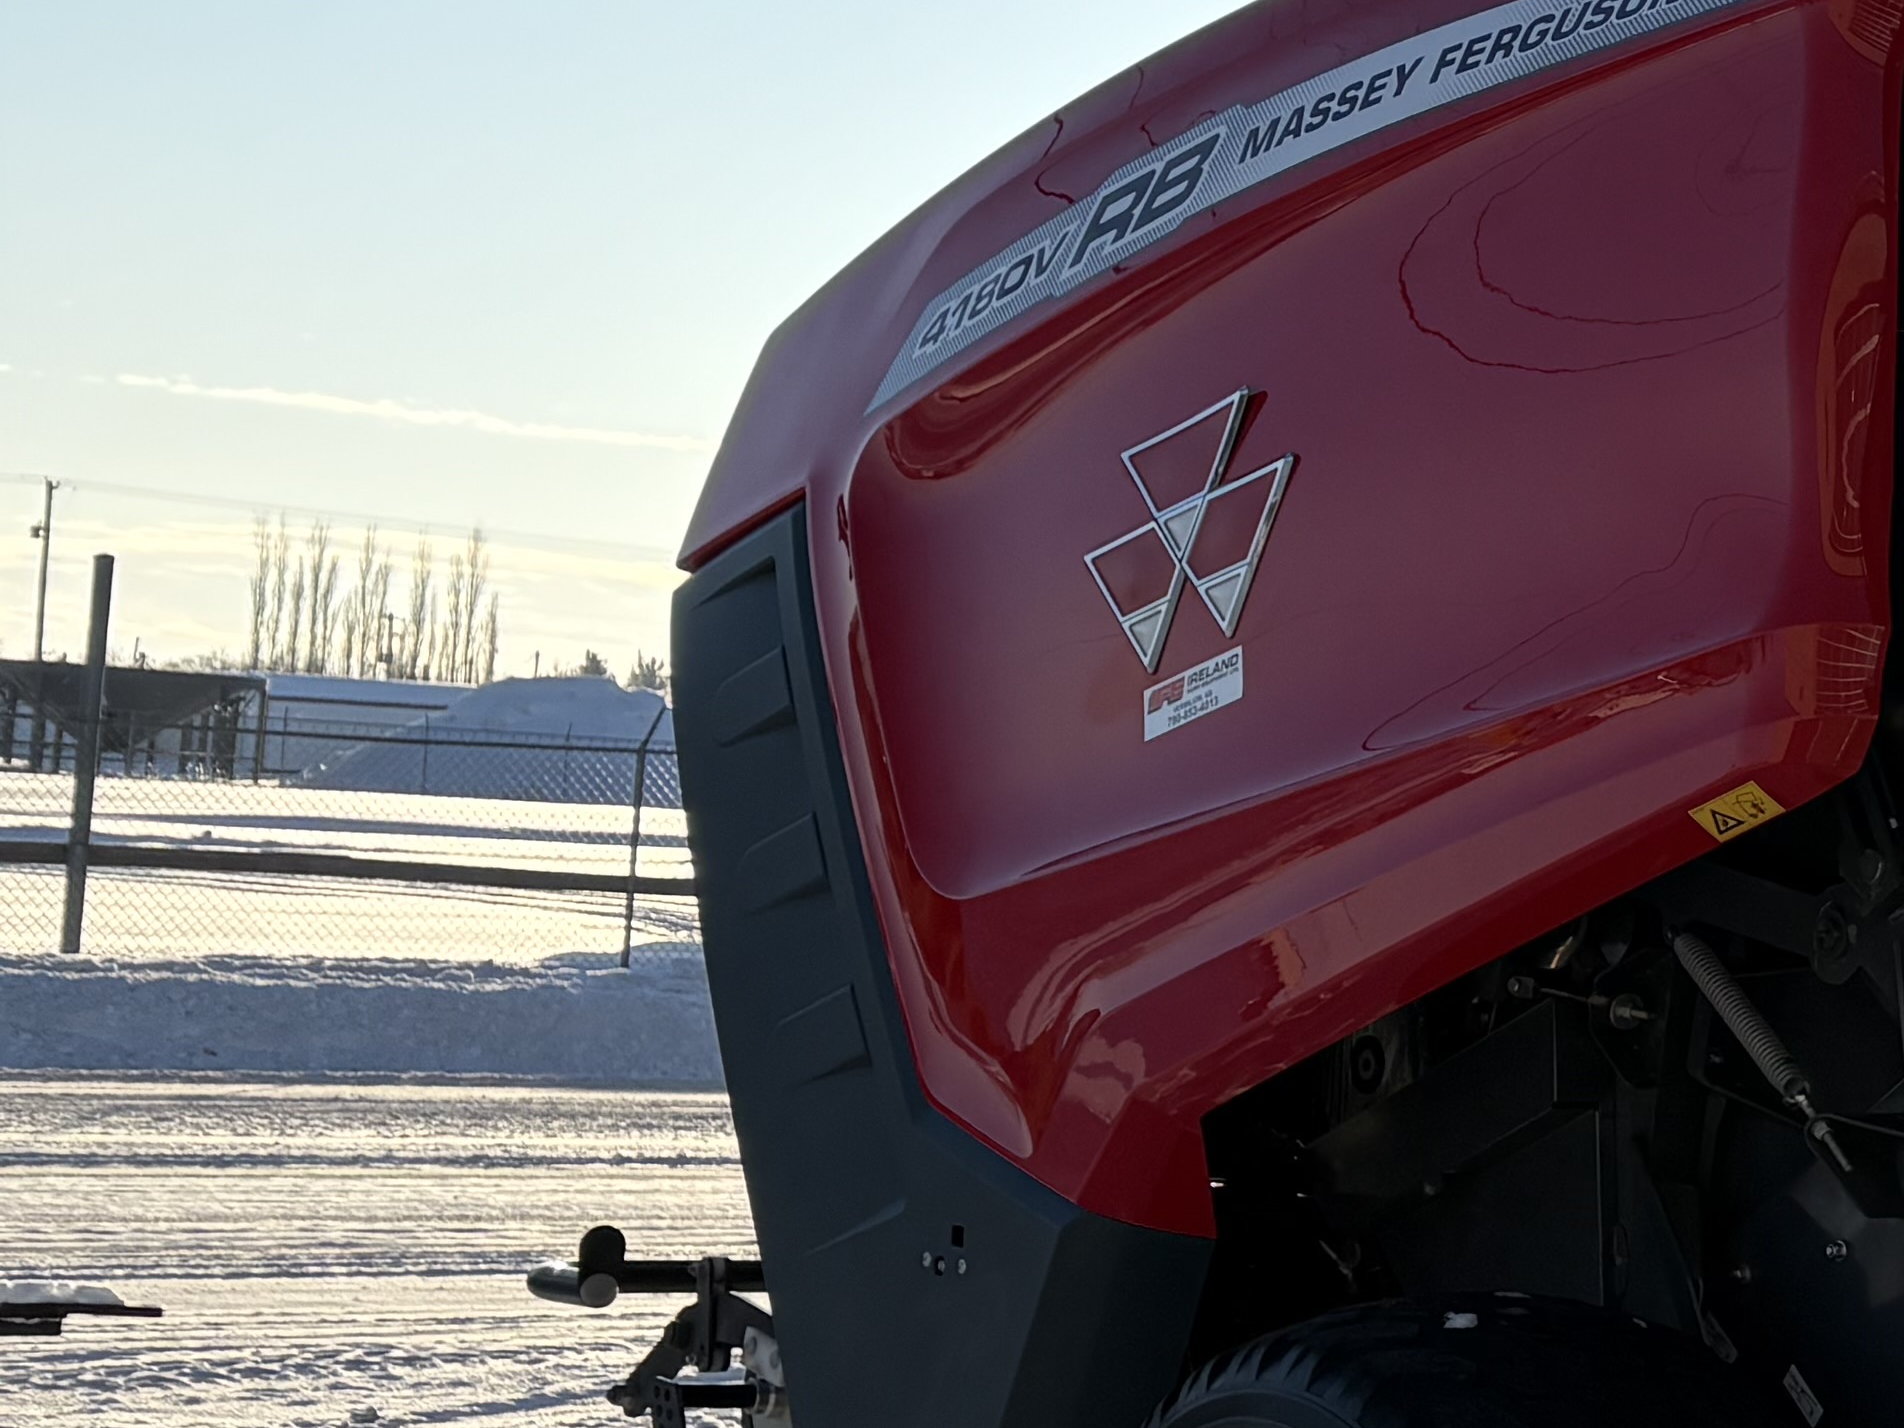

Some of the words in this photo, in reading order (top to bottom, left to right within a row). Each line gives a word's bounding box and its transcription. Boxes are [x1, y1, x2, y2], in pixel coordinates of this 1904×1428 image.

[918, 229, 1070, 350] 4180V
[1067, 132, 1222, 269] RB
[1238, 56, 1426, 165] MASSEY
[1187, 653, 1240, 687] IRELAND
